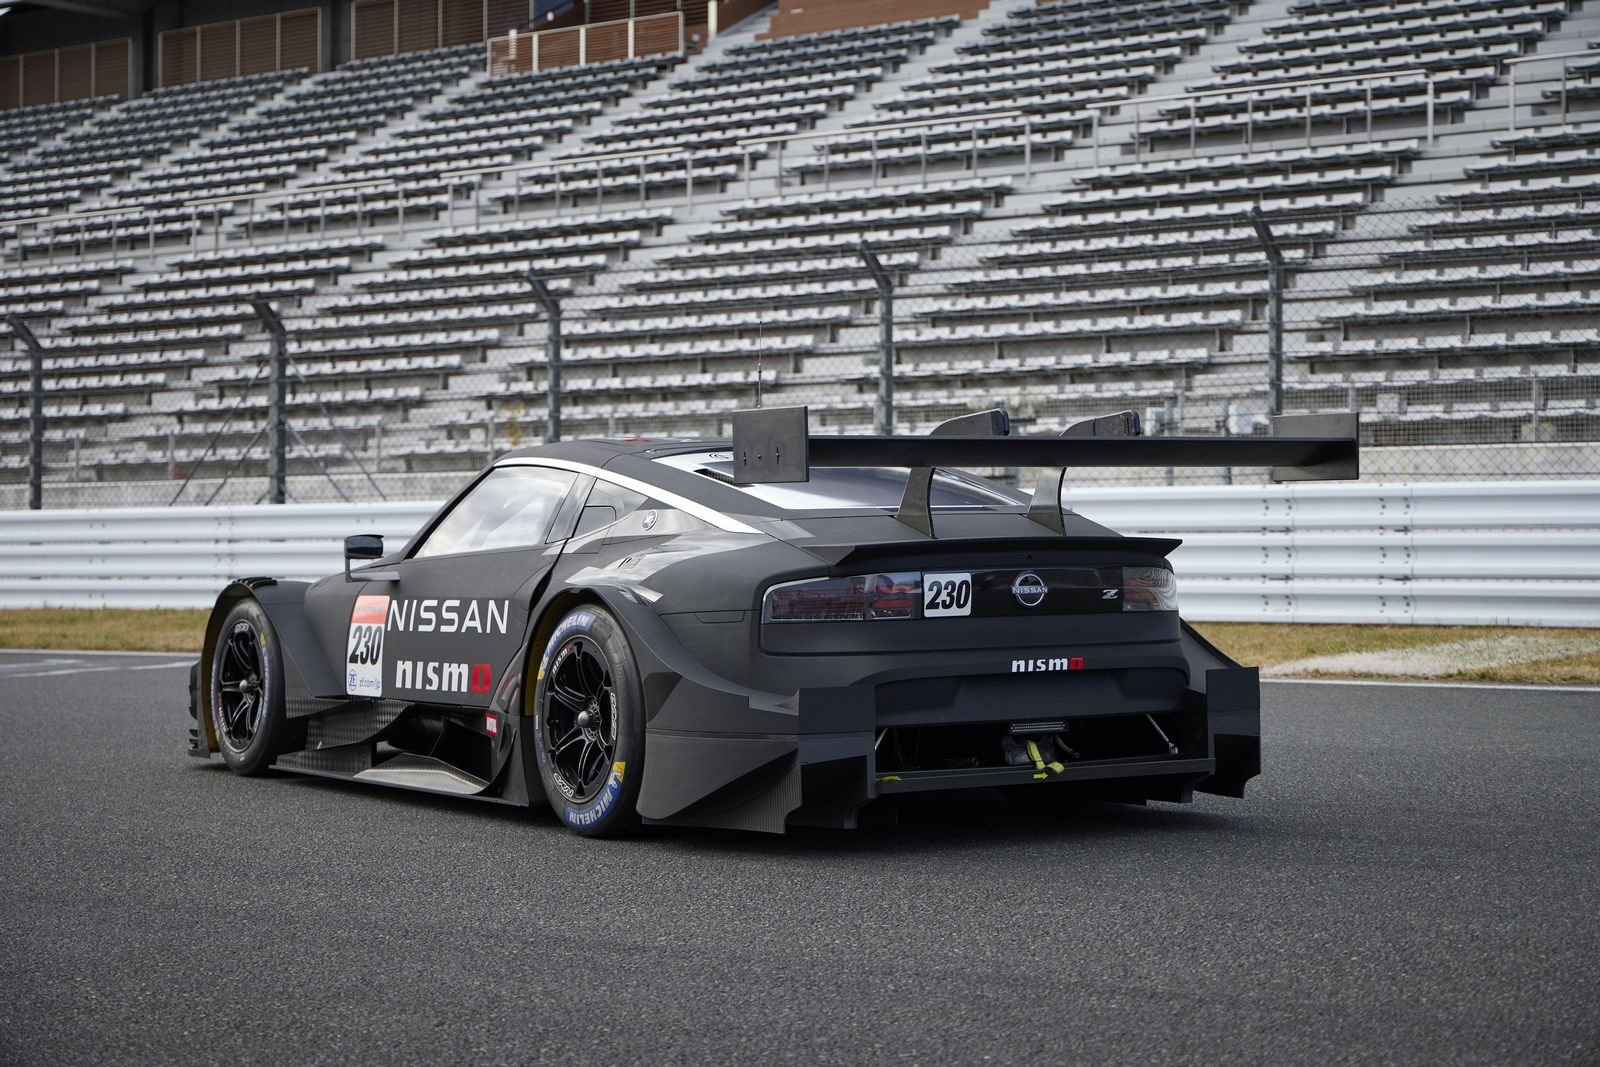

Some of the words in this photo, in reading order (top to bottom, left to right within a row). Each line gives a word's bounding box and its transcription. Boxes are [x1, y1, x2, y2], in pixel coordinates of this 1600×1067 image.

[925, 580, 970, 610] 230
[1011, 585, 1048, 595] NISSAN
[1102, 589, 1118, 599] Z
[387, 600, 509, 634] NISSAN
[349, 625, 382, 666] 230
[395, 660, 491, 694] nismo
[1011, 657, 1084, 673] nismo
[569, 788, 613, 825] MICHELIN
